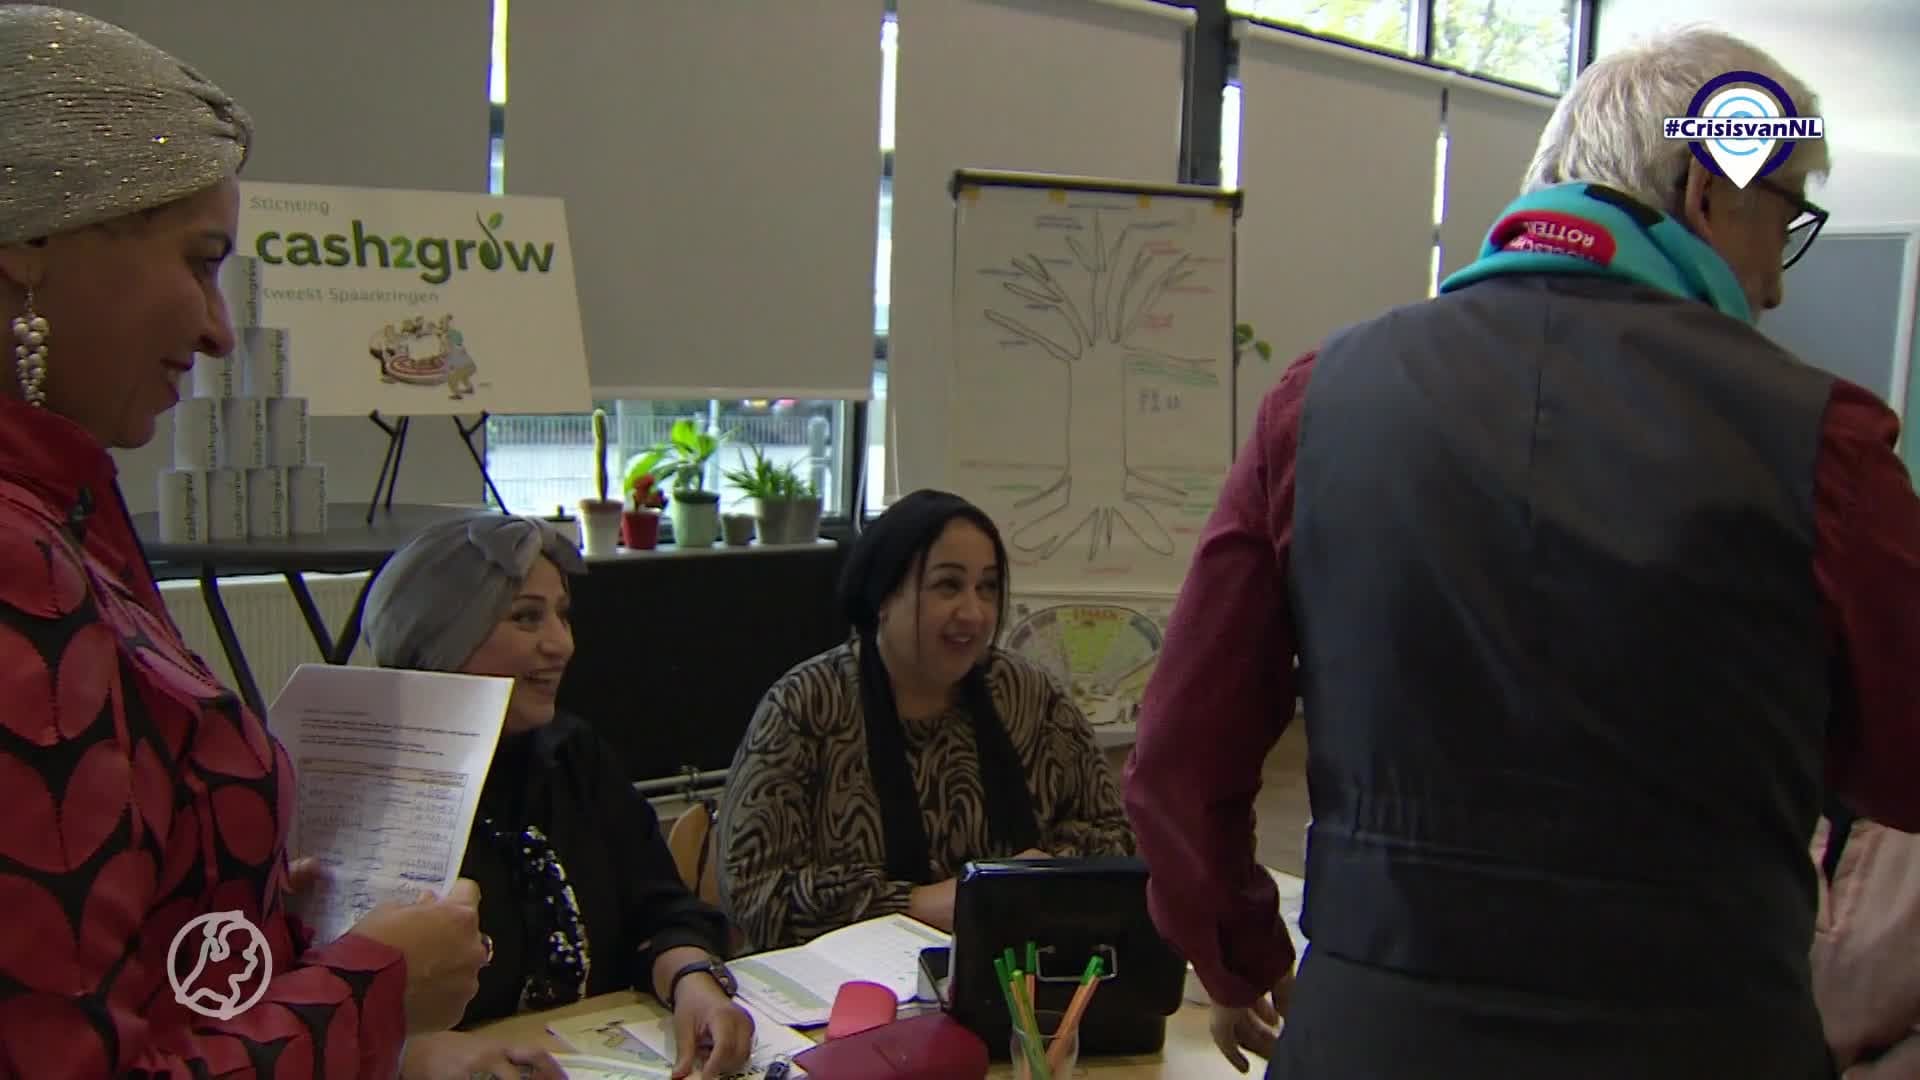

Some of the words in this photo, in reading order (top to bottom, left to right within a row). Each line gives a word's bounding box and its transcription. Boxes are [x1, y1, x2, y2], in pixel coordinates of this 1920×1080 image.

[249, 195, 330, 214] Stichting
[256, 212, 555, 285] cash2grow
[327, 287, 440, 305] Spaarkringen
